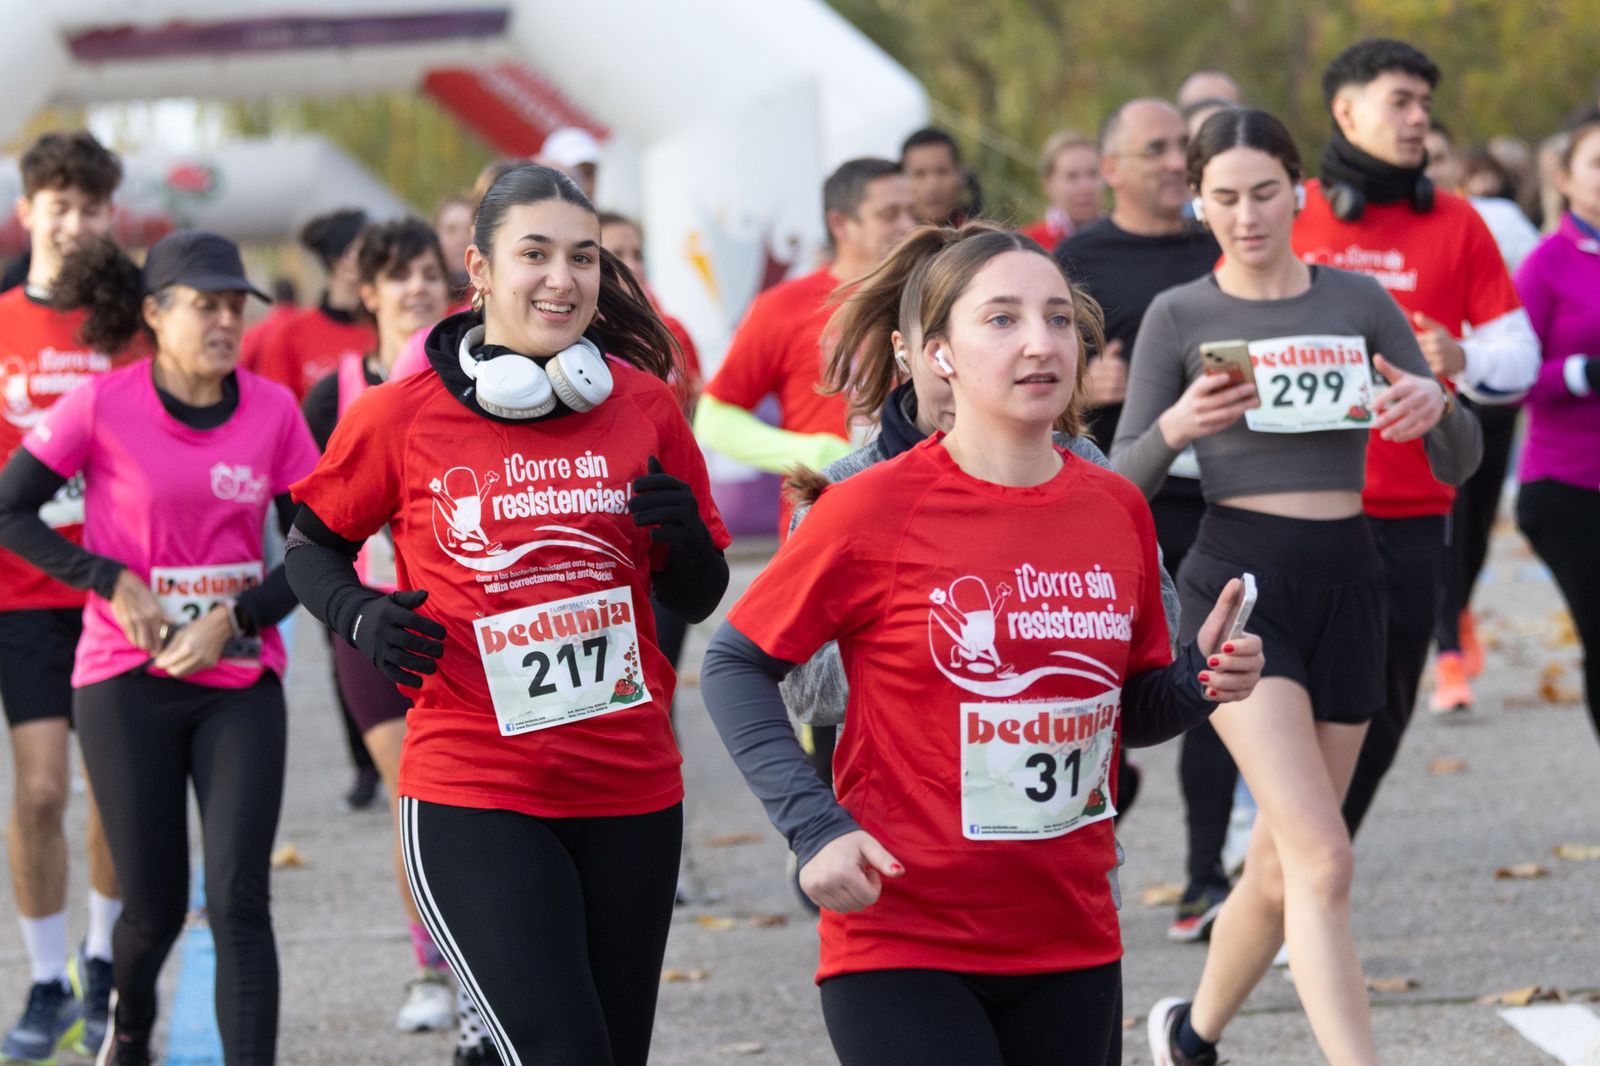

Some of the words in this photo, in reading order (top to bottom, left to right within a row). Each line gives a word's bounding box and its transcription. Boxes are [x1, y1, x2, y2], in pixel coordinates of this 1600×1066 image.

[1270, 371, 1345, 407] 299
[503, 453, 571, 487] ¡Corre
[574, 450, 608, 479] sin
[491, 482, 632, 520] resistencias!
[1015, 563, 1083, 602] ¡Corre
[1085, 564, 1117, 600] sin
[480, 598, 632, 655] bedunia
[522, 635, 608, 698] 217
[968, 703, 1115, 744] bedunia
[1025, 748, 1082, 803] 31
